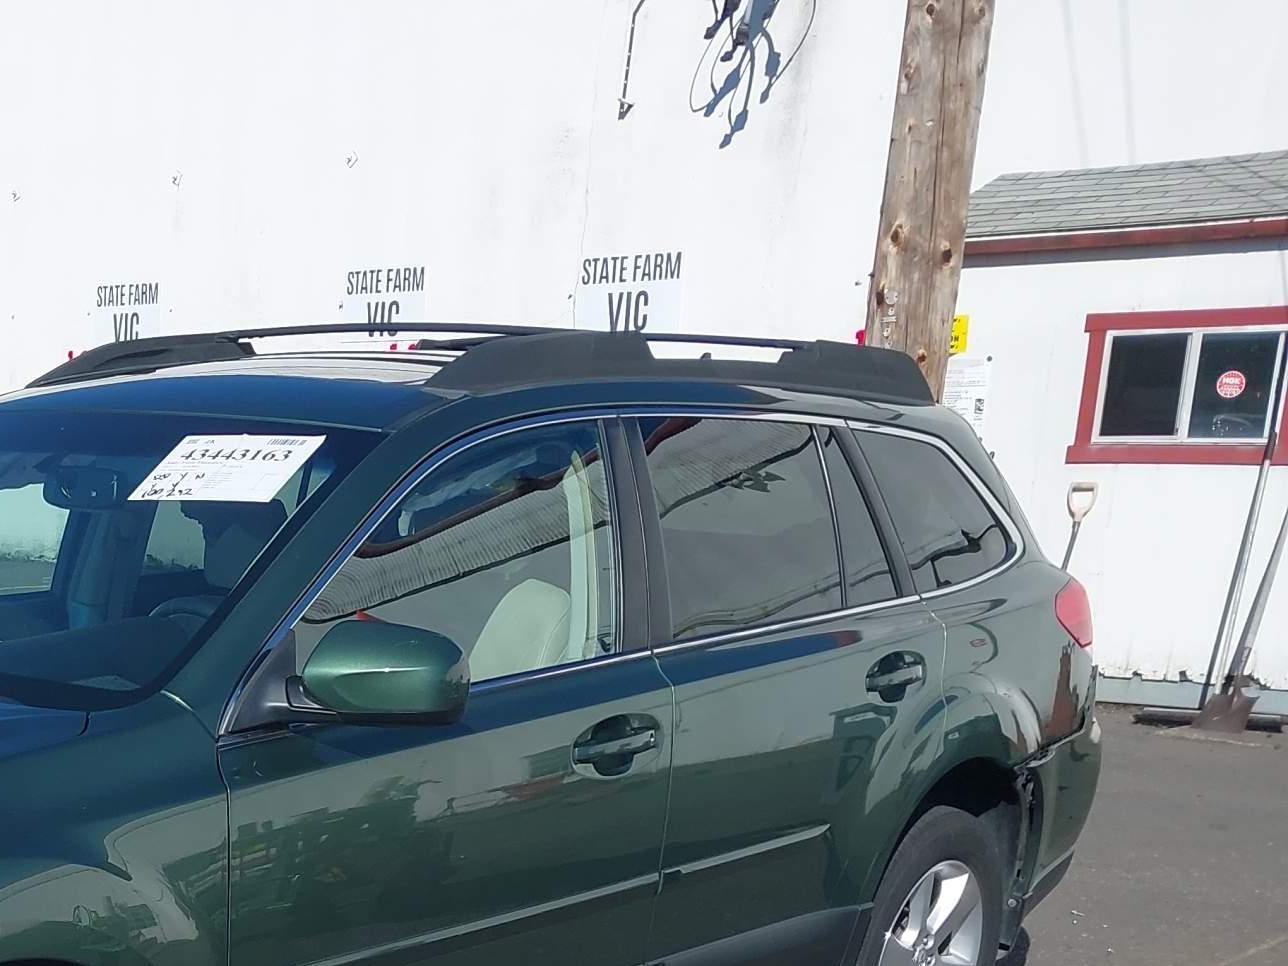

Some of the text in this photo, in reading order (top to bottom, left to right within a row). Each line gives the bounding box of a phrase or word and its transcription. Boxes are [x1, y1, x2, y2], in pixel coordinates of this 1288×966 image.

[347, 266, 425, 295] STATE FARM
[582, 251, 682, 285] STATE FARM
[97, 282, 159, 308] STATE FARM
[608, 290, 649, 332] VIC
[113, 312, 140, 344] VIC
[367, 301, 400, 337] VIC
[181, 448, 293, 461] 43443163
